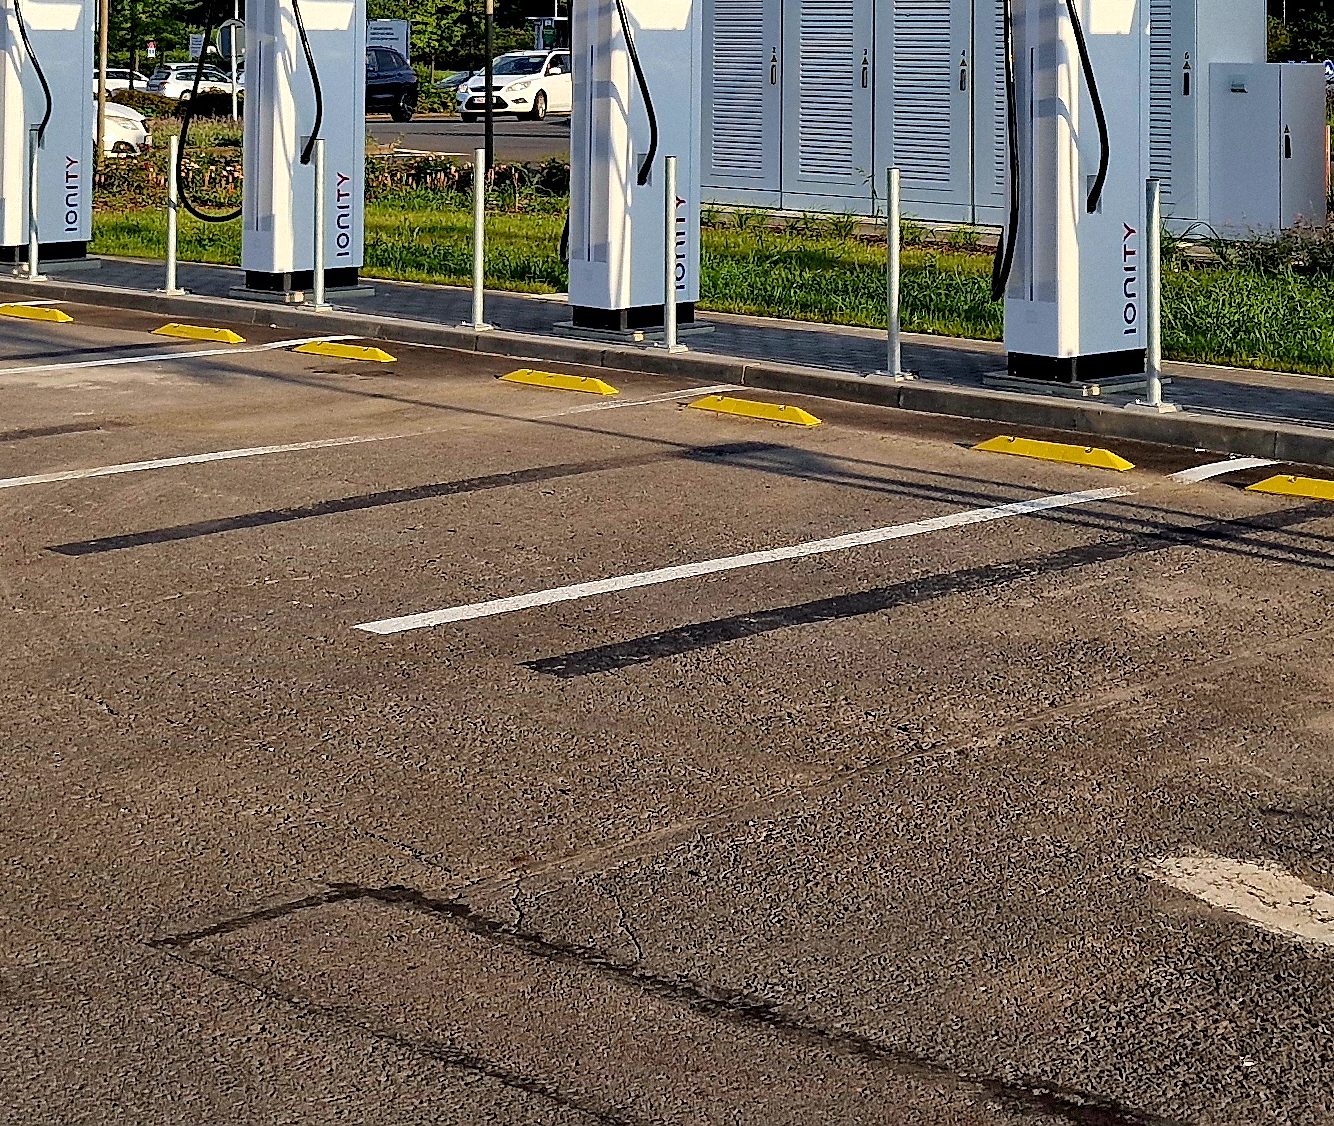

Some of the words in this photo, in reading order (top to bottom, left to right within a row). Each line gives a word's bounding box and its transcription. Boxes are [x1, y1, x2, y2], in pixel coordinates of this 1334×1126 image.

[64, 155, 79, 232] IONITY
[336, 171, 351, 257] IONITY
[1123, 222, 1137, 335] IONITY
